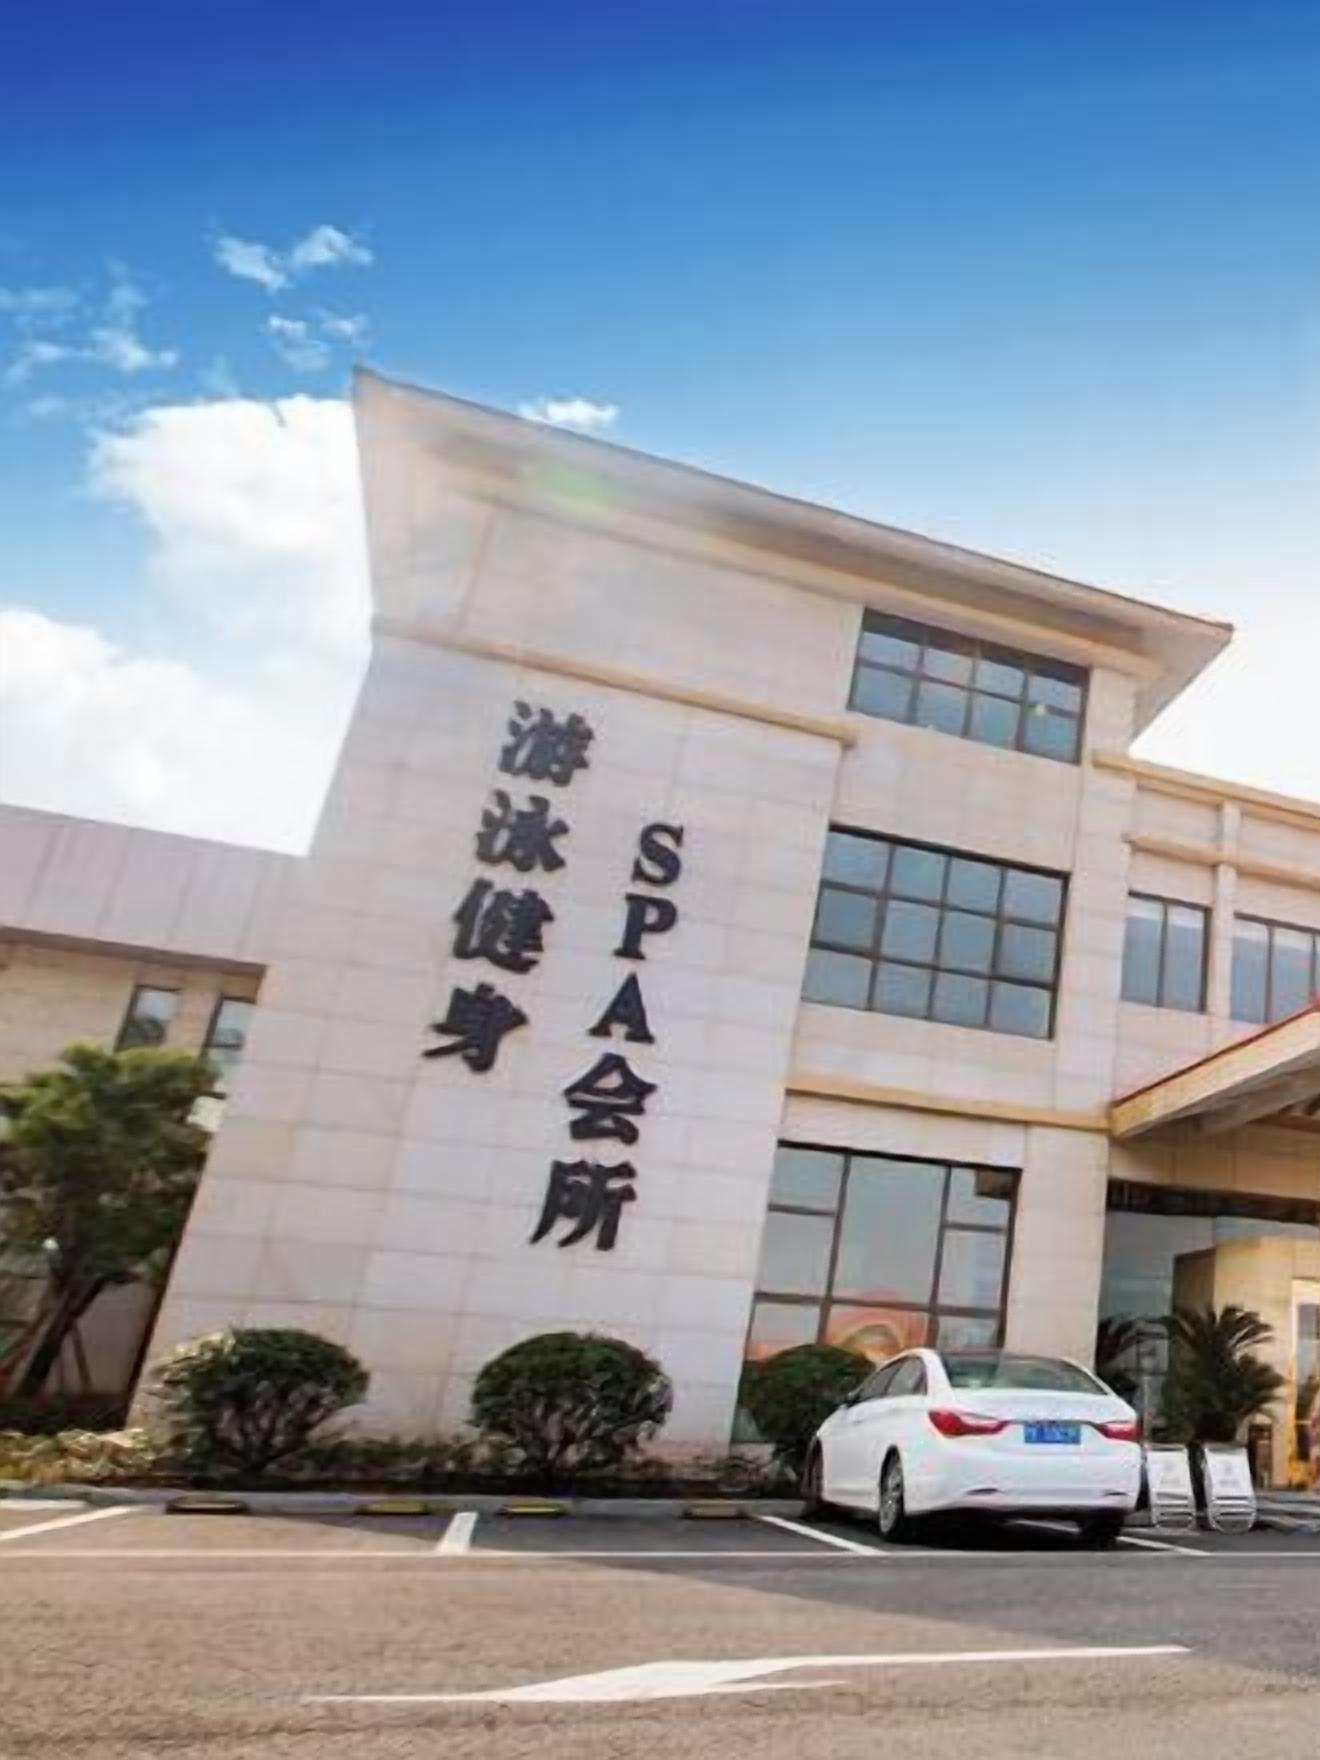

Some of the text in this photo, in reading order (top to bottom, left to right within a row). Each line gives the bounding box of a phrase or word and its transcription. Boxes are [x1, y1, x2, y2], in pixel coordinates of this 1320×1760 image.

[422, 700, 594, 1074] 游泳健身
[529, 823, 684, 1251] SPA会所
